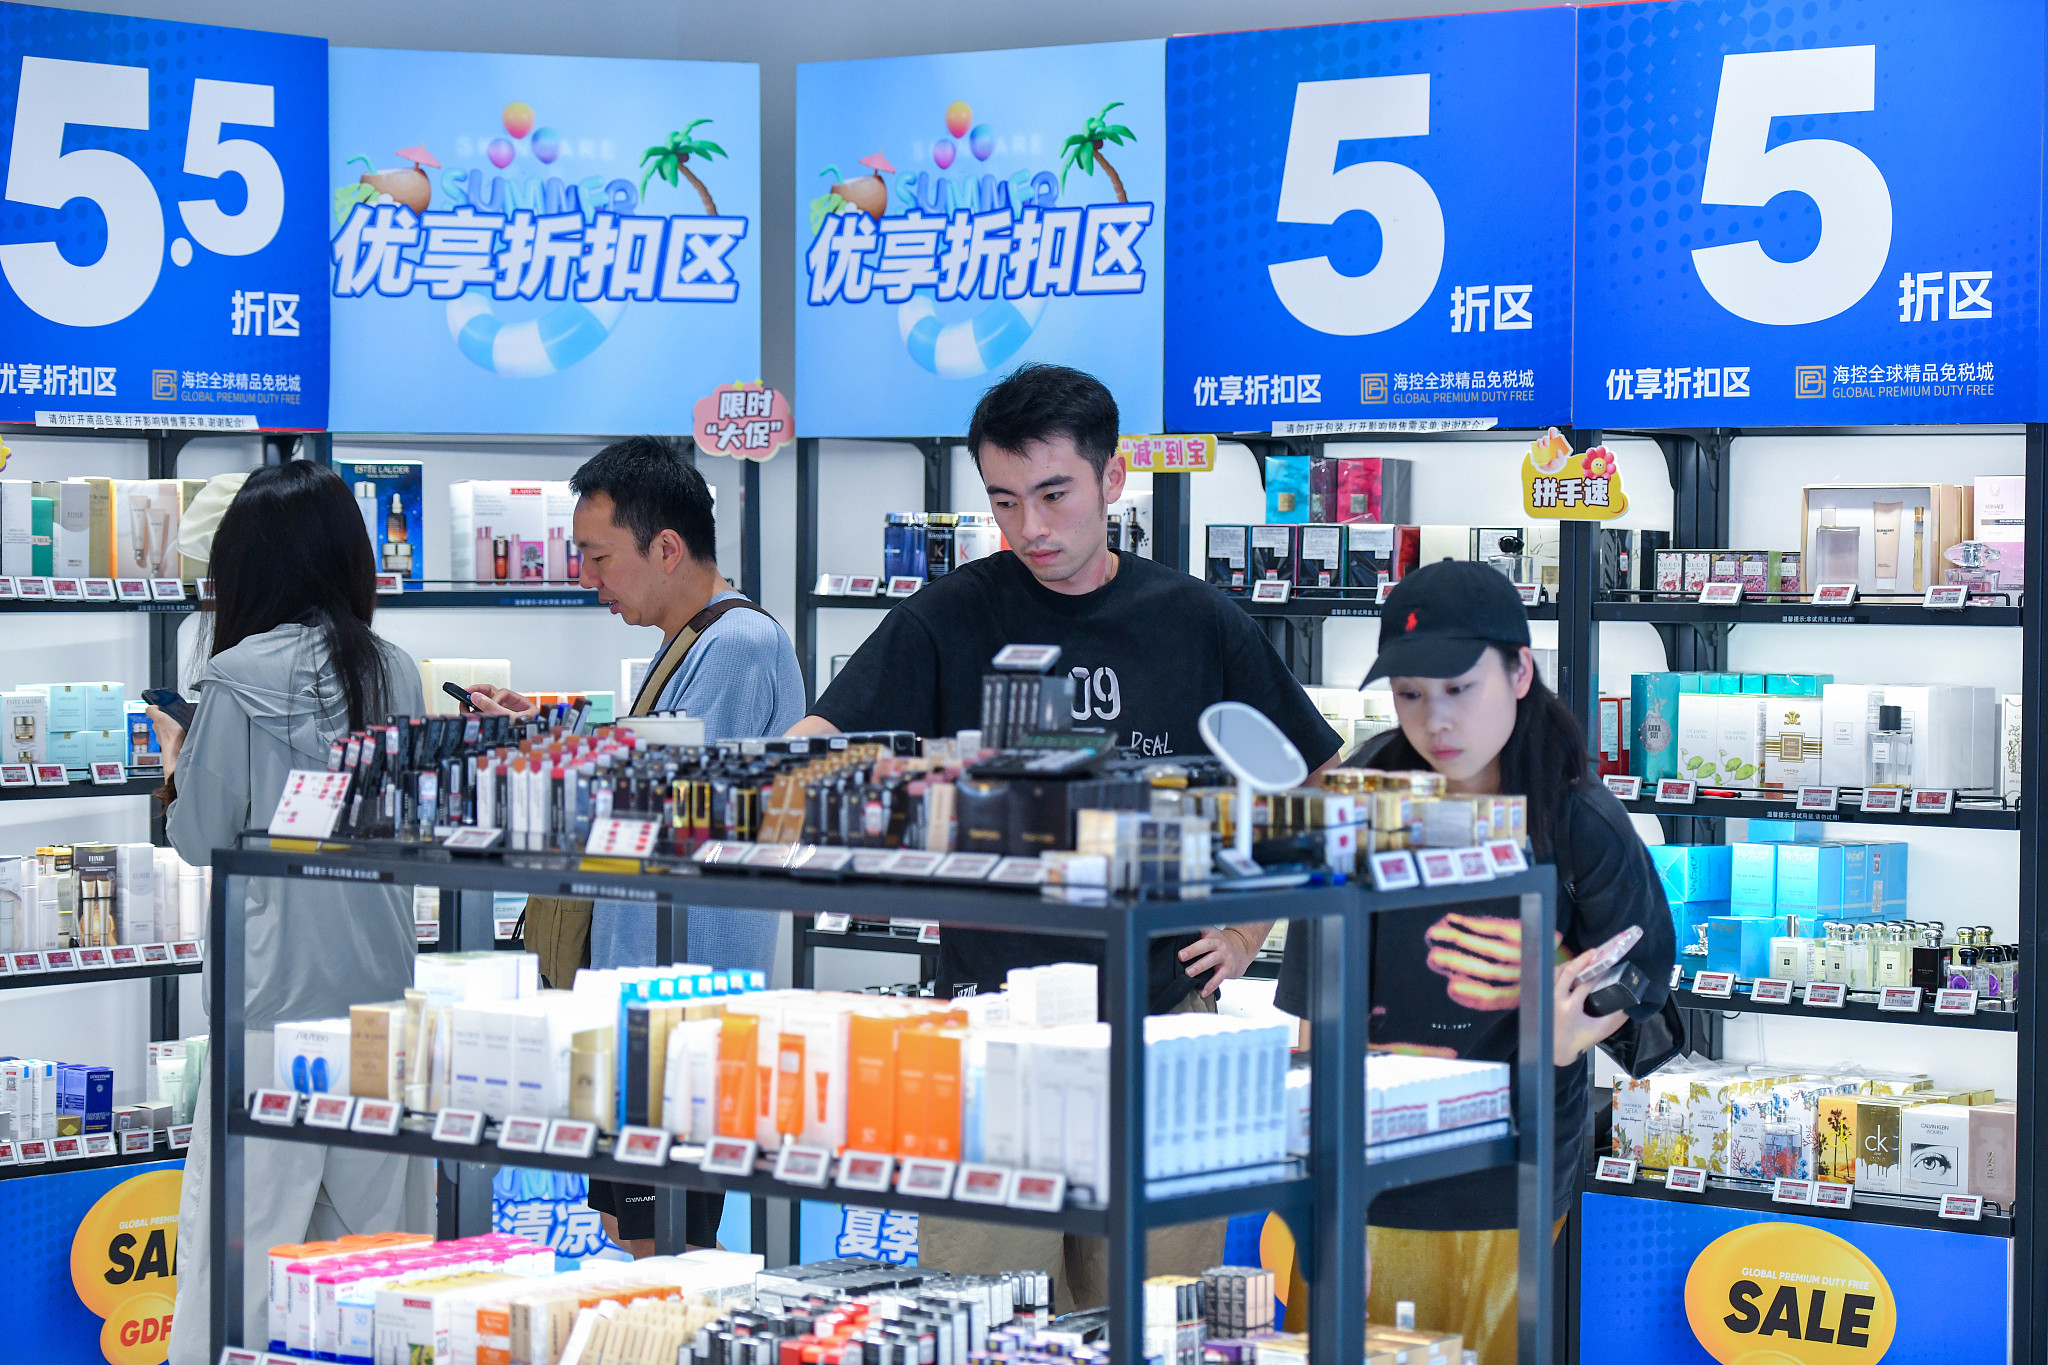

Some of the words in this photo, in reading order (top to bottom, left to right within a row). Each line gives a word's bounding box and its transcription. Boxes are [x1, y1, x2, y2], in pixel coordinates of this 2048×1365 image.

[0, 56, 285, 327] 5.5
[1691, 44, 1893, 326] 5
[1267, 73, 1445, 337] 5
[331, 203, 748, 303] 优享折扣区
[806, 202, 1154, 305] 优享折扣区
[1450, 284, 1533, 334] 折区
[1898, 270, 1993, 322] 折区
[231, 290, 300, 338] 折区
[0, 362, 117, 397] 优享折扣区
[182, 371, 301, 392] 海控全球精品免税城
[1393, 370, 1535, 391] 海控全球精品免税城
[1606, 367, 1751, 401] 优享折扣区
[1832, 362, 1994, 384] 海控全球精品免税城
[181, 391, 214, 402] GLOBAL
[217, 392, 255, 403] PREMIUM
[257, 393, 279, 404] DUTY
[281, 394, 301, 405] FREE
[718, 388, 774, 420] 限时
[1194, 374, 1321, 406] 优享折扣区
[1393, 392, 1431, 404] GLOBAL
[1433, 391, 1479, 403] PREMIUM
[1481, 390, 1507, 402] DUTY
[1510, 390, 1534, 401] FREE
[1832, 386, 1875, 399] GLOBAL
[1878, 385, 1929, 398] PREMIUM
[1932, 385, 1961, 397] DUTY
[1964, 384, 1994, 396] FREE
[1531, 477, 1610, 508] 拼手速
[1647, 724, 1661, 732] ANNA
[1649, 731, 1659, 739] SUI
[1826, 1119, 1852, 1149] ck
[1864, 1124, 1889, 1153] ck
[1920, 1122, 1936, 1130] CALVIN
[119, 1218, 149, 1230] GLOBAL
[104, 1229, 178, 1285] SA
[1741, 1267, 1777, 1281] GLOBAL
[1779, 1271, 1820, 1286] PREMIUM
[1822, 1276, 1847, 1289] DUTY
[1848, 1278, 1870, 1291] FREE
[1722, 1279, 1876, 1349] SALE
[119, 1314, 173, 1347] GDF
